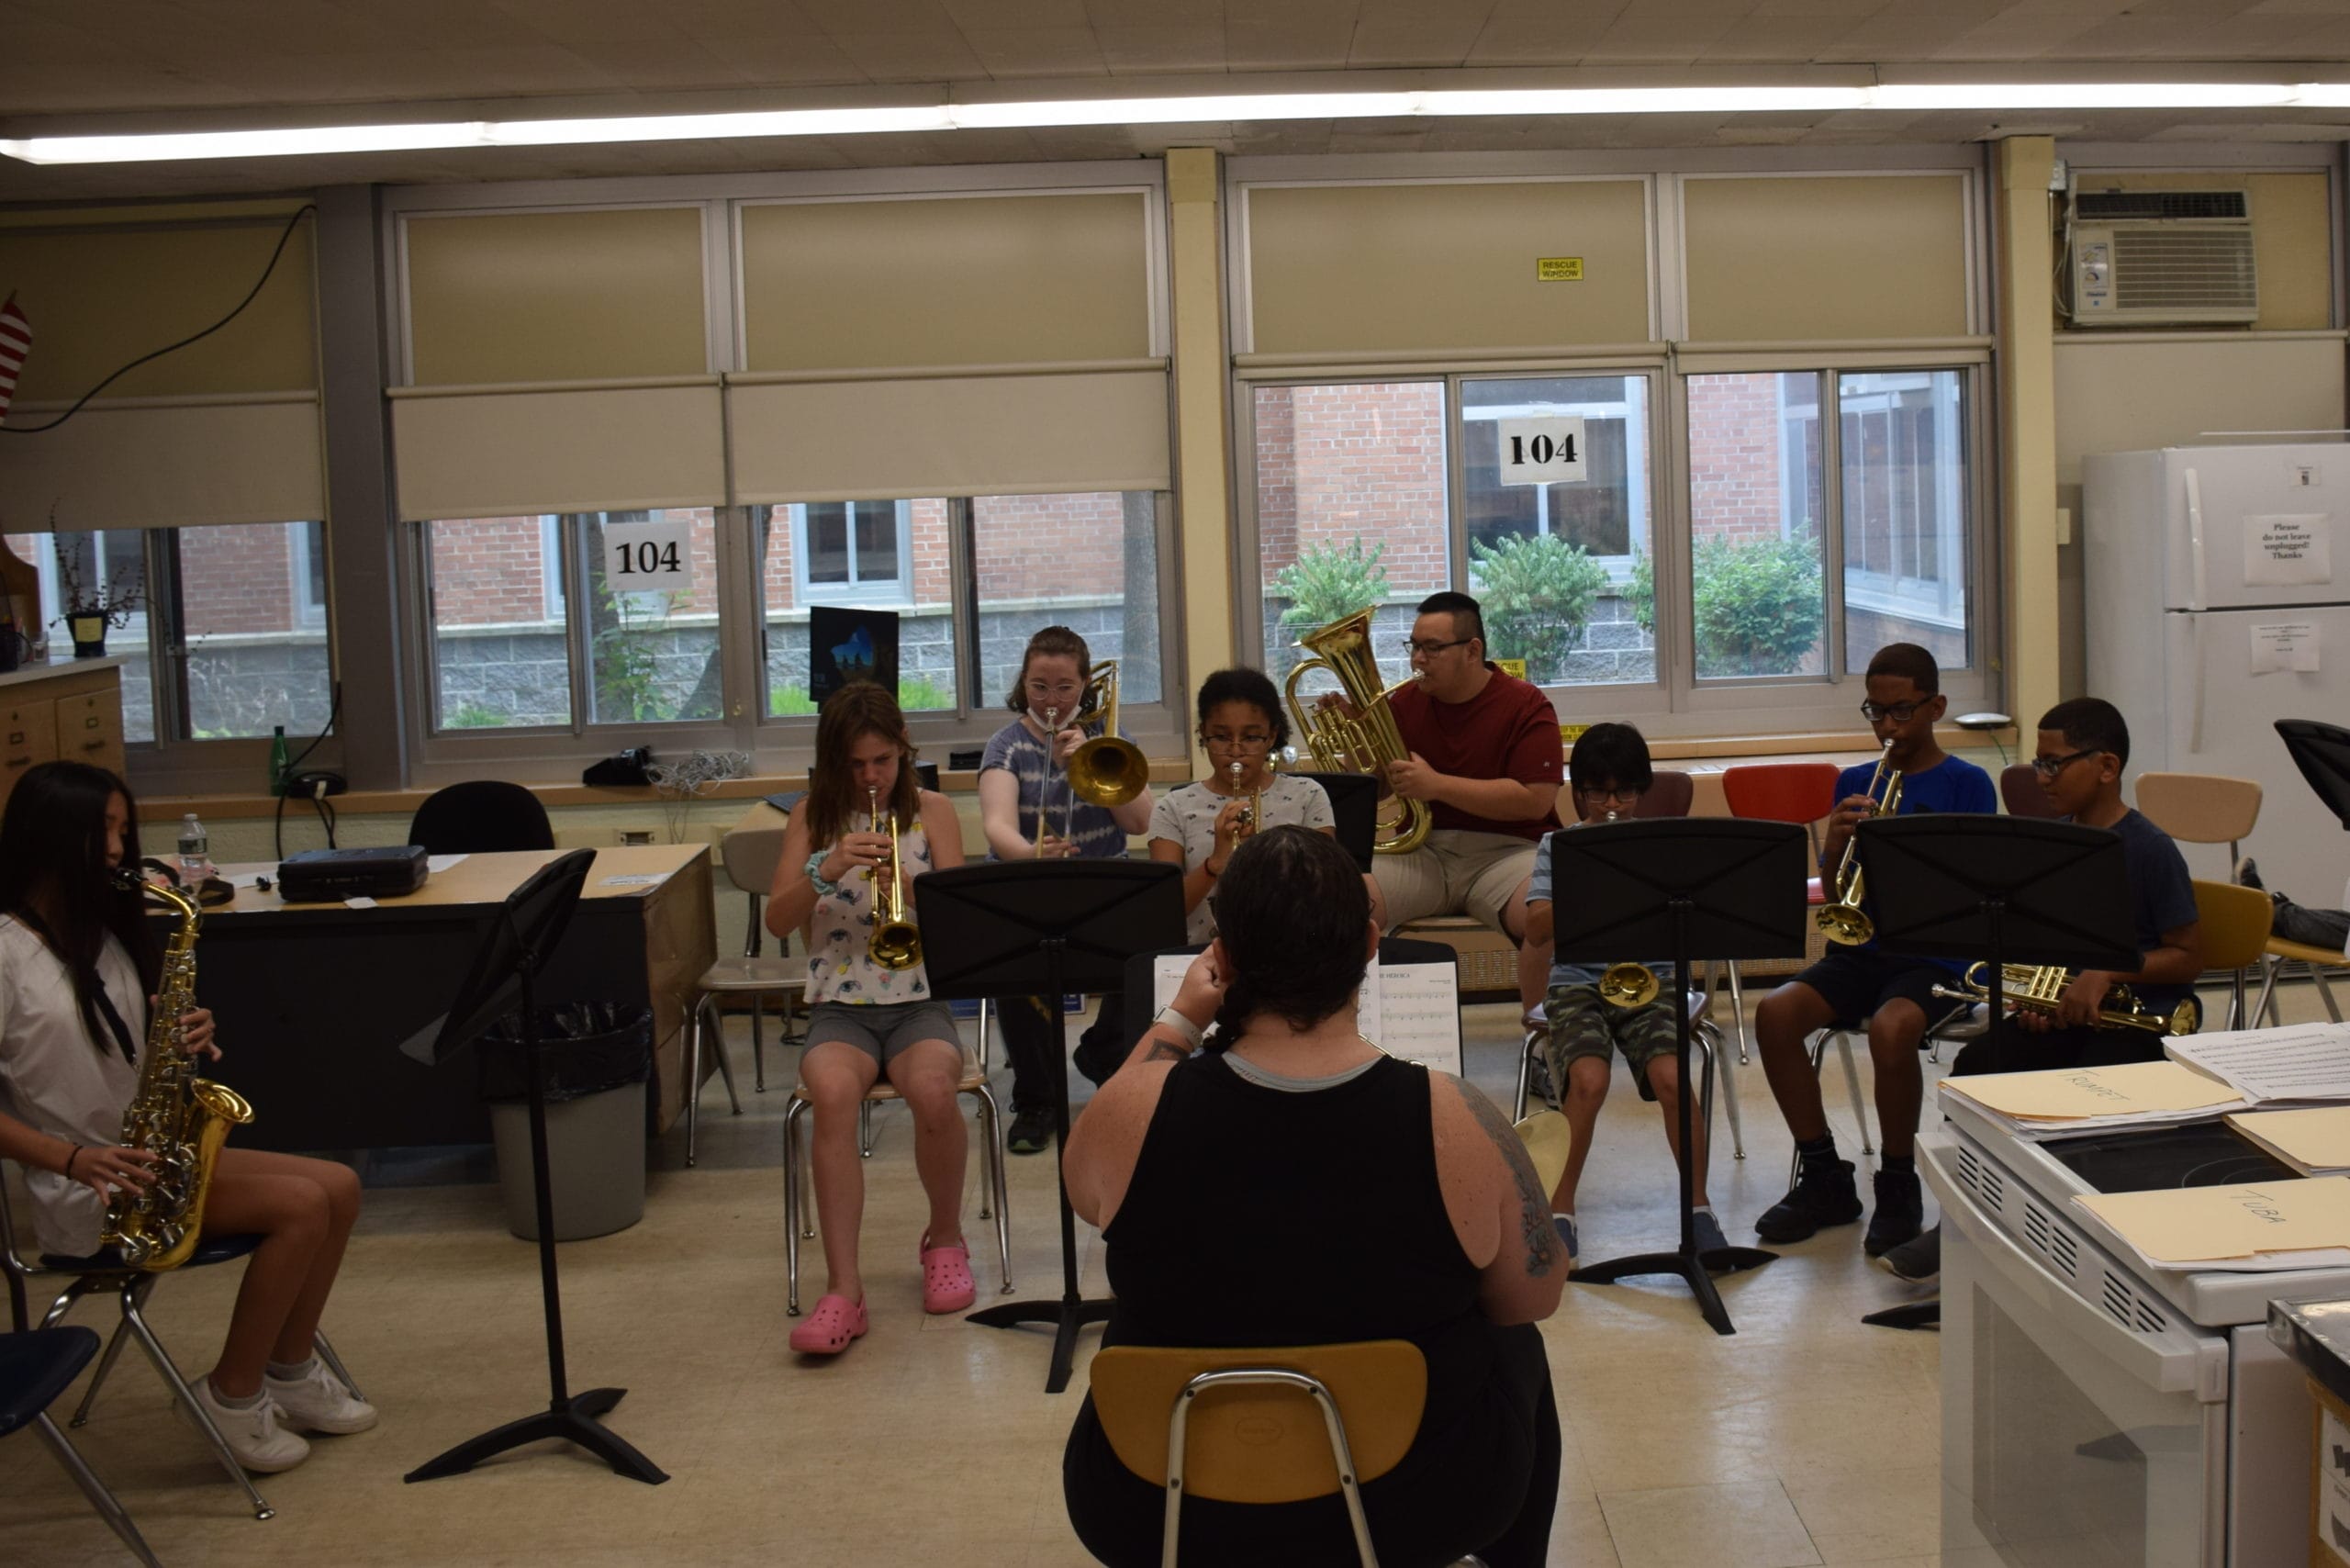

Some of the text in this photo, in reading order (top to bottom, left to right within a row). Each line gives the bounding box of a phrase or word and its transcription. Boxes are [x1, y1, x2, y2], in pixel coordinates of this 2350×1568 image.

[1542, 261, 1578, 269] RESCUE
[1542, 269, 1579, 277] WINDOW
[1510, 433, 1578, 465] 104
[2264, 542, 2311, 551] unplugged!
[2272, 551, 2303, 559] Thanks
[616, 541, 681, 574] 104
[2056, 1070, 2131, 1102] TRUMPET
[2230, 1189, 2287, 1224] TUBA
